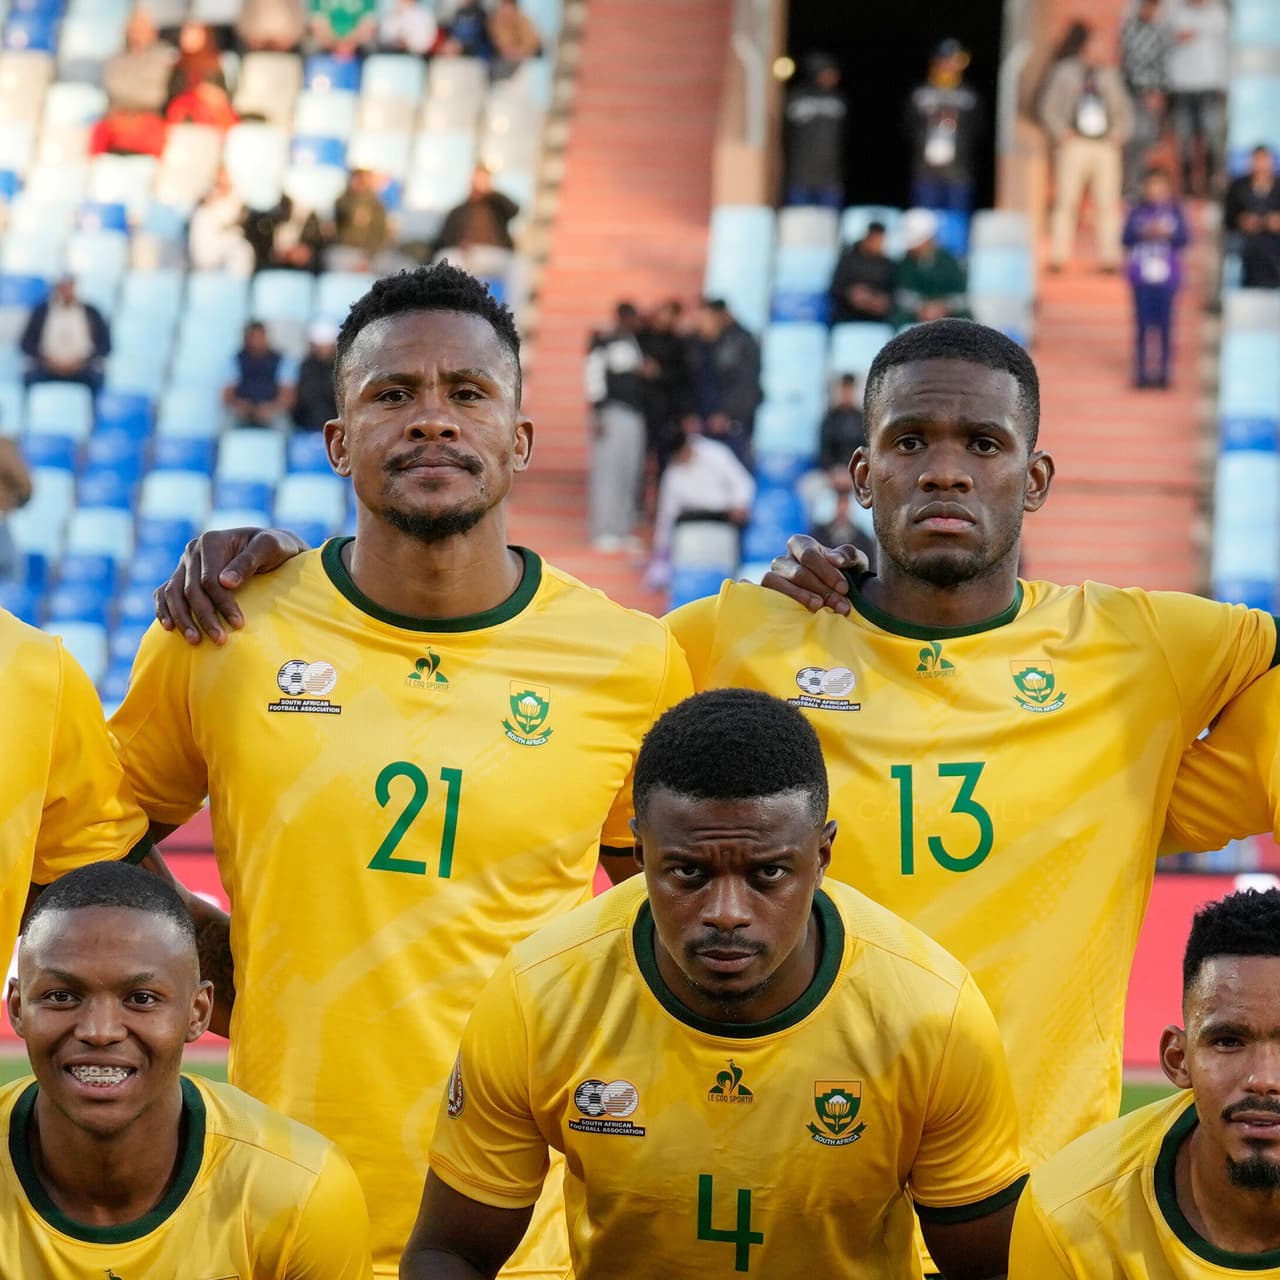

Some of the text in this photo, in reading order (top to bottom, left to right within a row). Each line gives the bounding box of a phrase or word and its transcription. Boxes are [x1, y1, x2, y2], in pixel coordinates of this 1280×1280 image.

[1022, 700, 1064, 712] SOUTH AFRICA
[507, 730, 548, 746] SOUTH AFRICA
[369, 762, 462, 877] 21
[891, 762, 993, 874] 13
[570, 1122, 644, 1135] FOOTBALL ASSOCIATION
[581, 1119, 603, 1127] SOUTH
[814, 1134, 861, 1145] SOUTH AFRICA
[699, 1176, 762, 1270] 4
